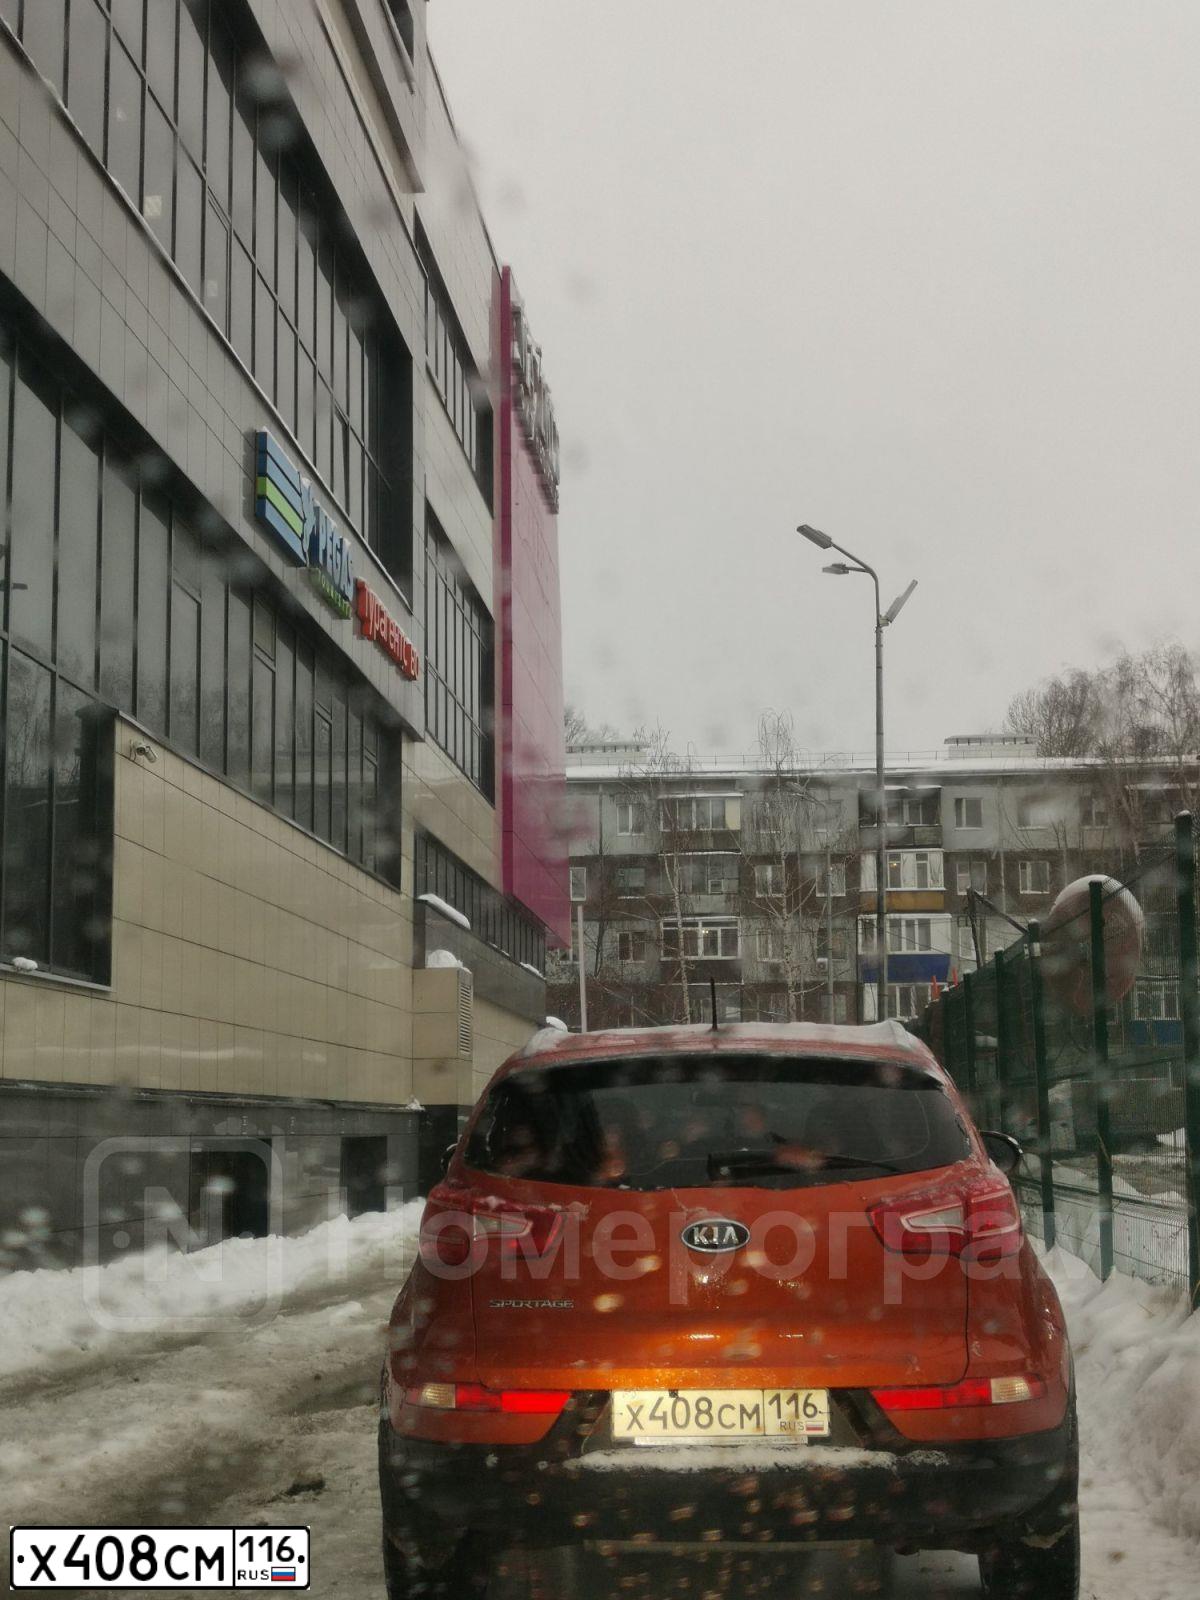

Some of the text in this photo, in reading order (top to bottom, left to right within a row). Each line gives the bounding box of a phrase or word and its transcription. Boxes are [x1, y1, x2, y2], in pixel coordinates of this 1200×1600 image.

[693, 1226, 739, 1245] KIA
[489, 1299, 574, 1309] SPORTAGE
[768, 1392, 818, 1419] 116
[780, 1421, 805, 1431] RUS
